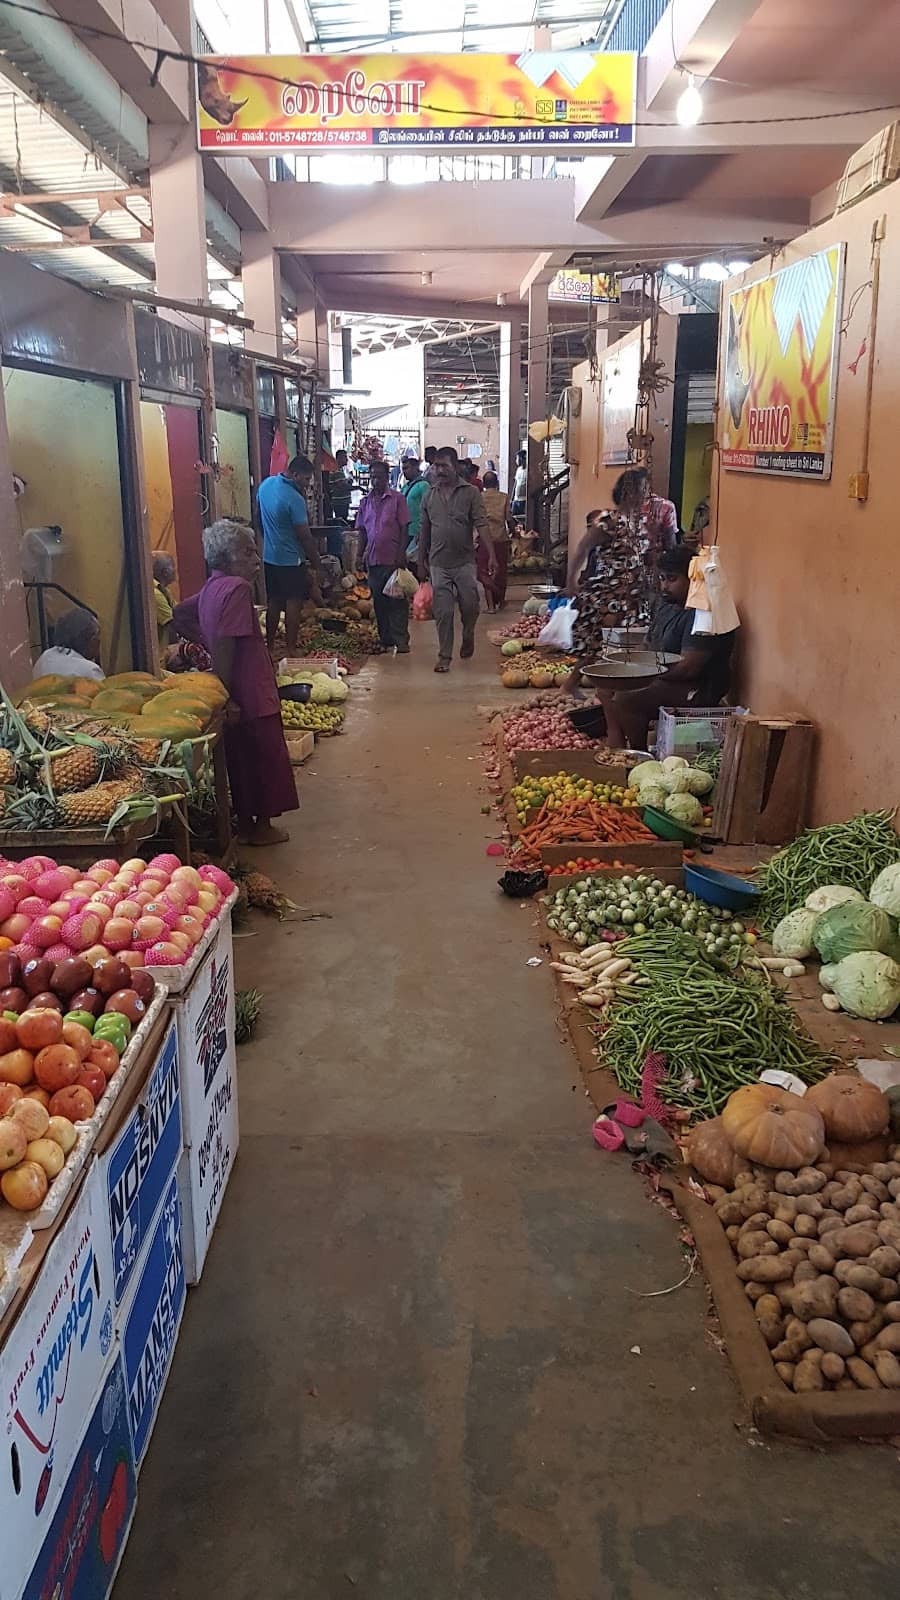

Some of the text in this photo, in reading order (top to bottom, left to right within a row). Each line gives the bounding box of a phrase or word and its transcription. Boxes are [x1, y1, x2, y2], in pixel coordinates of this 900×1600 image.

[282, 70, 424, 123] றைனோ
[749, 406, 791, 446] RHINO
[109, 1054, 178, 1239] MANSON
[205, 1145, 231, 1236] APPLES
[35, 1247, 93, 1417] Stemilt
[36, 1275, 69, 1348] Famous
[130, 1235, 183, 1435] MANSON
[150, 1305, 175, 1408] APPLES
[9, 1349, 36, 1407] Fruit
